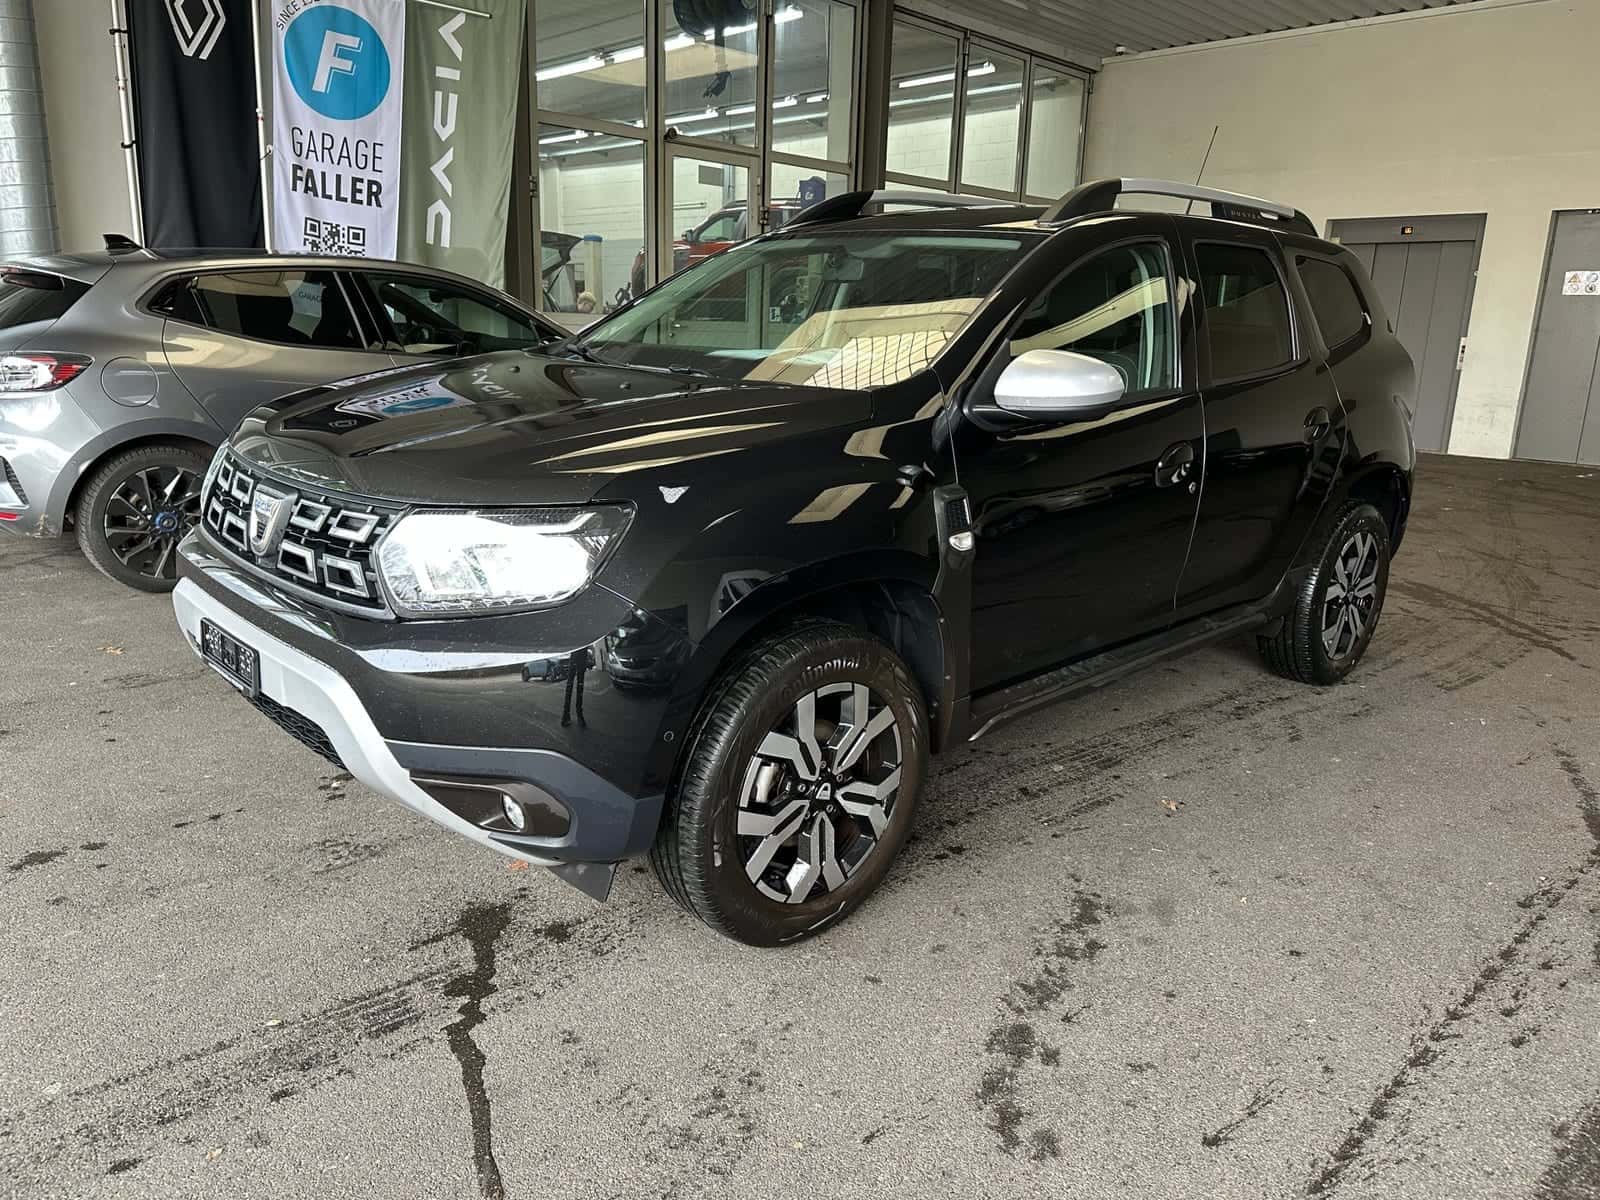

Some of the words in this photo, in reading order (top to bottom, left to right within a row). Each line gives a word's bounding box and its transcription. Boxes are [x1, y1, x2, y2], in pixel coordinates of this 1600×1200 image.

[276, 0, 301, 31] SINCE
[312, 29, 364, 95] F
[291, 126, 384, 173] GARAGE
[291, 163, 383, 208] FALLER
